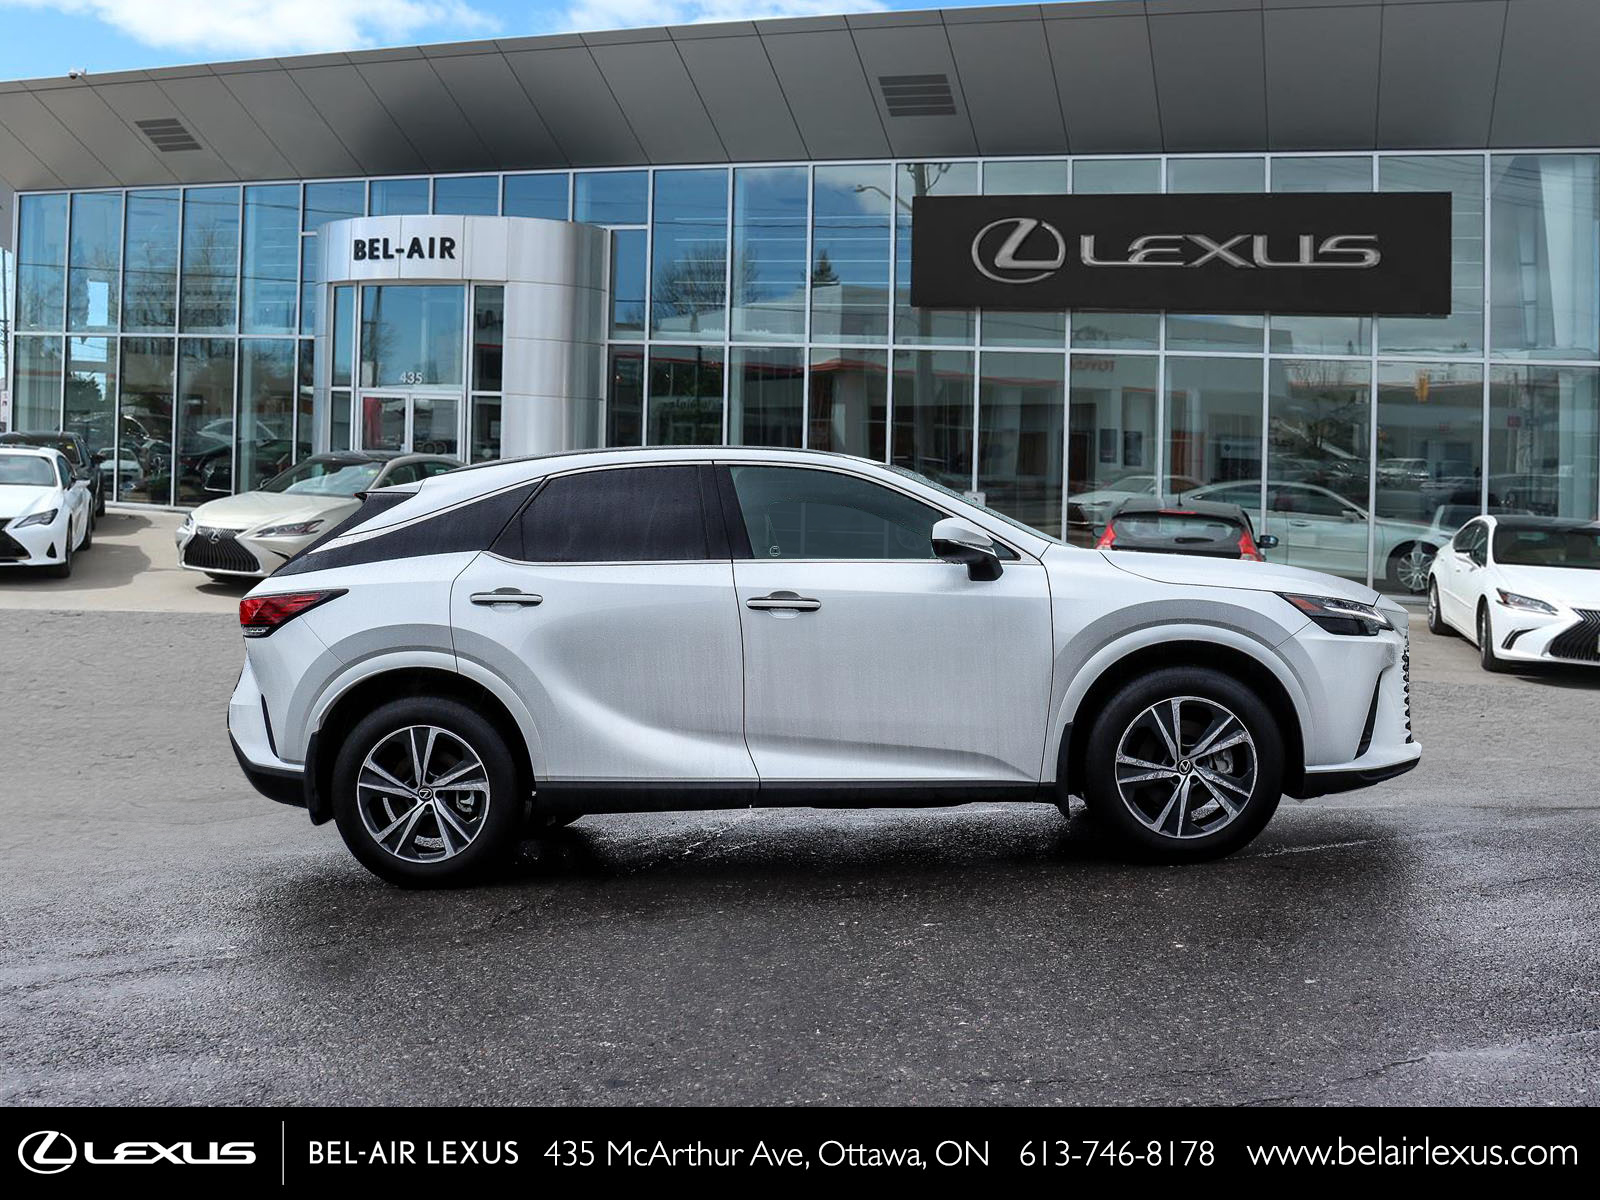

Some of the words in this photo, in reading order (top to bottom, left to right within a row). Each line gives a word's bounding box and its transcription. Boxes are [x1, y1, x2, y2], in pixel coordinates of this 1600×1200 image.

[353, 236, 457, 261] BEL-AIR
[1080, 233, 1381, 269] LEXUS
[399, 370, 424, 385] 435
